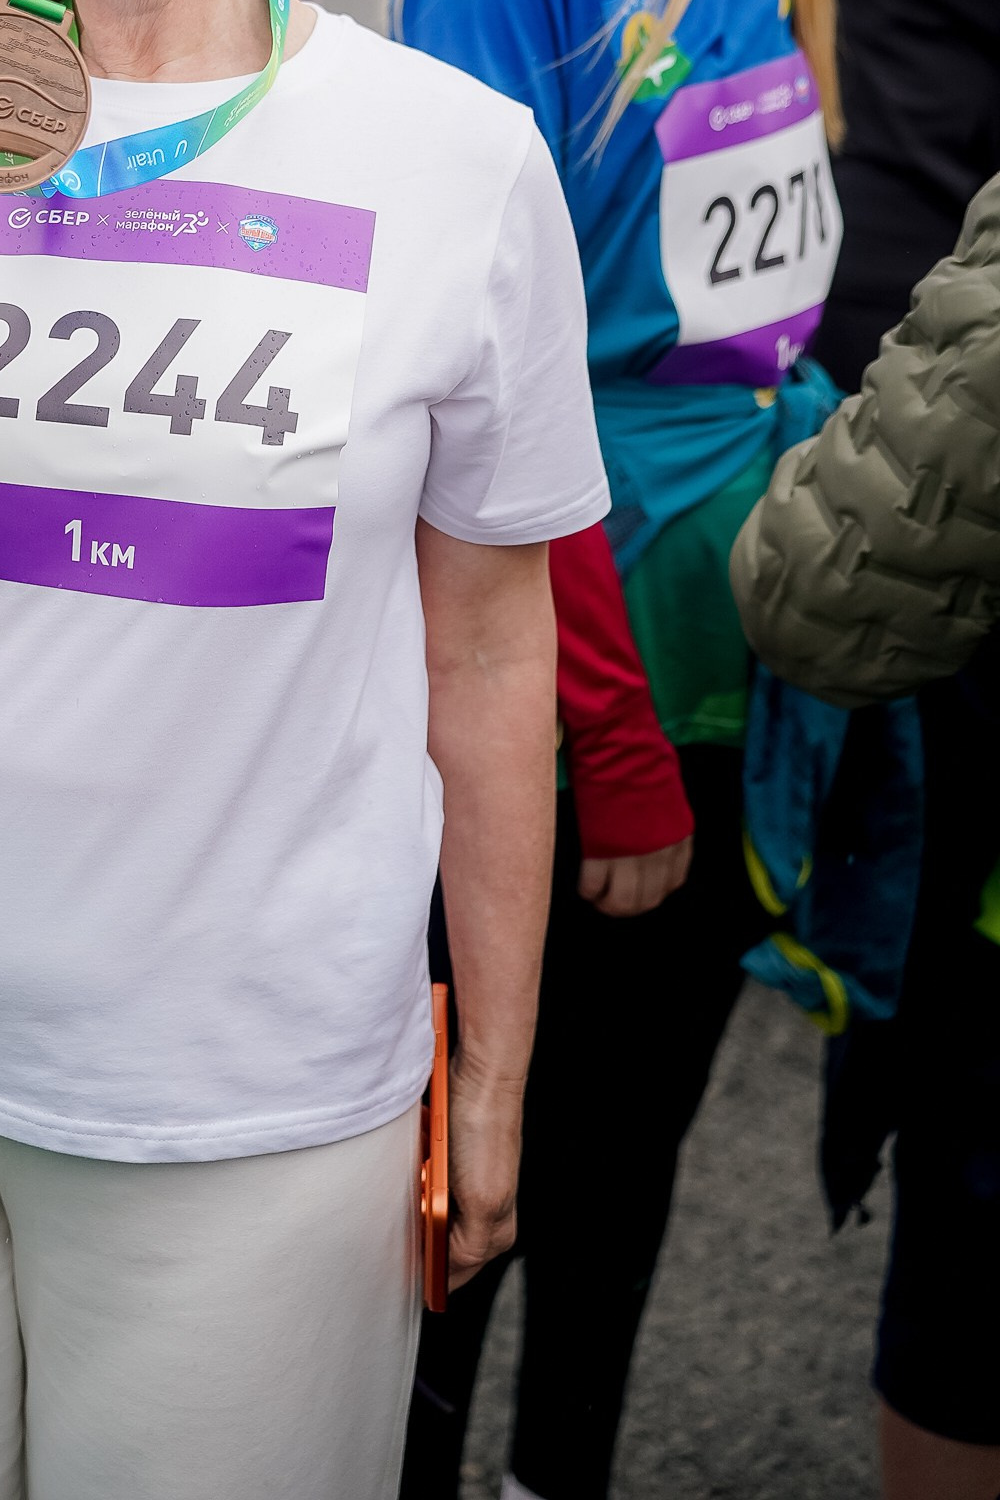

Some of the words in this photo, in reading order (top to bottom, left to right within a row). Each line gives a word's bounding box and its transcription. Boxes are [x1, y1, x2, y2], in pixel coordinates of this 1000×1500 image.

[16, 108, 67, 134] СБЕР
[127, 149, 165, 171] Utair
[35, 209, 90, 226] СБЕР
[125, 208, 181, 221] зелёный
[115, 219, 174, 232] марафон
[64, 519, 82, 562] 1
[90, 540, 136, 569] км
